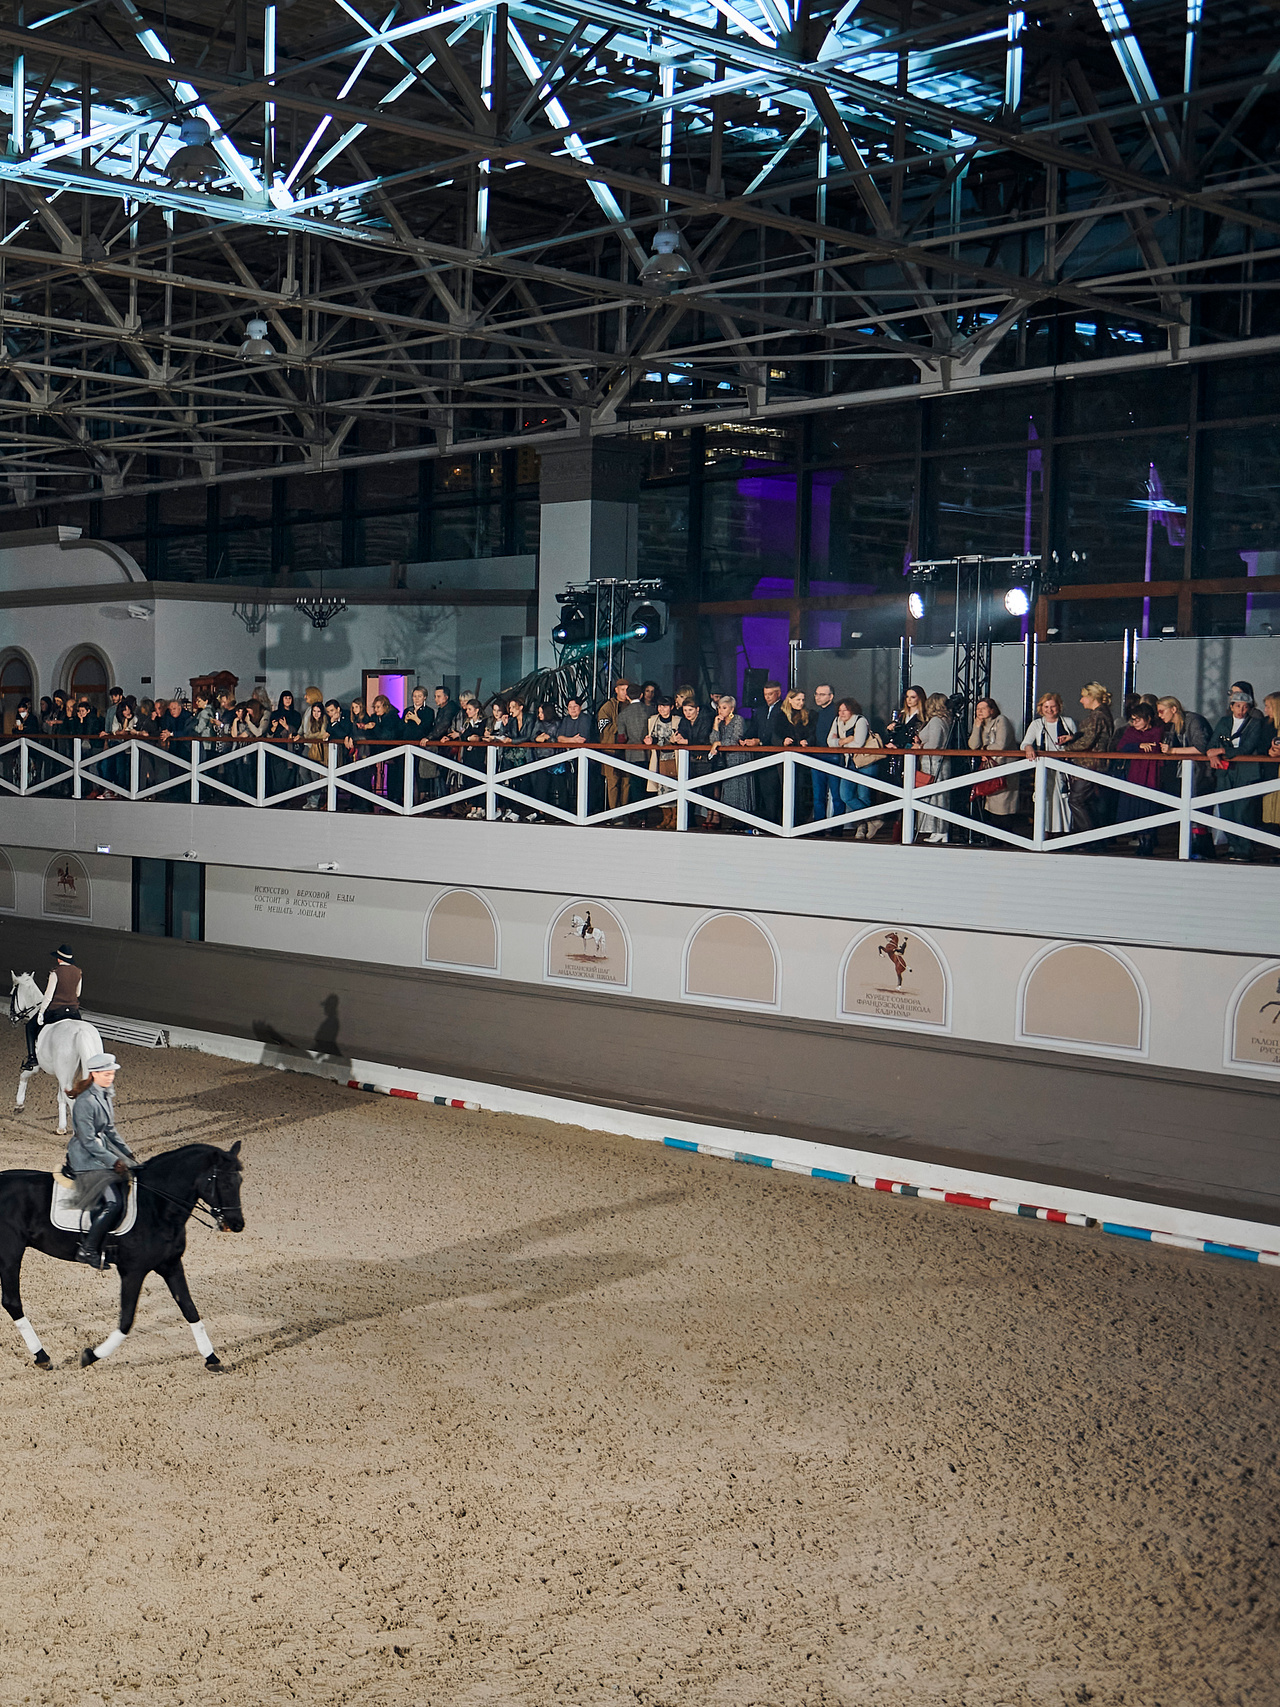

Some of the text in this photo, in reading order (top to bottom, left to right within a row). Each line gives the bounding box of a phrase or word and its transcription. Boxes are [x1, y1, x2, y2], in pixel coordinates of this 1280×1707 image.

[254, 885, 355, 903] ИСКУССТВО ВЕРХОВОЙ ЕЗДЫ
[254, 894, 282, 904] СОСТОИТ
[293, 898, 328, 909] ИСКУССТВЕ
[254, 904, 326, 919] НЕ МЕШАТЬ ЛОШАДИ
[856, 998, 932, 1014] ФРАНЦУЗСКАЯ ШКОЛА
[865, 992, 922, 1006] КУРБЕТ СОМЮРА
[1251, 1037, 1279, 1046] ГАЛОП
